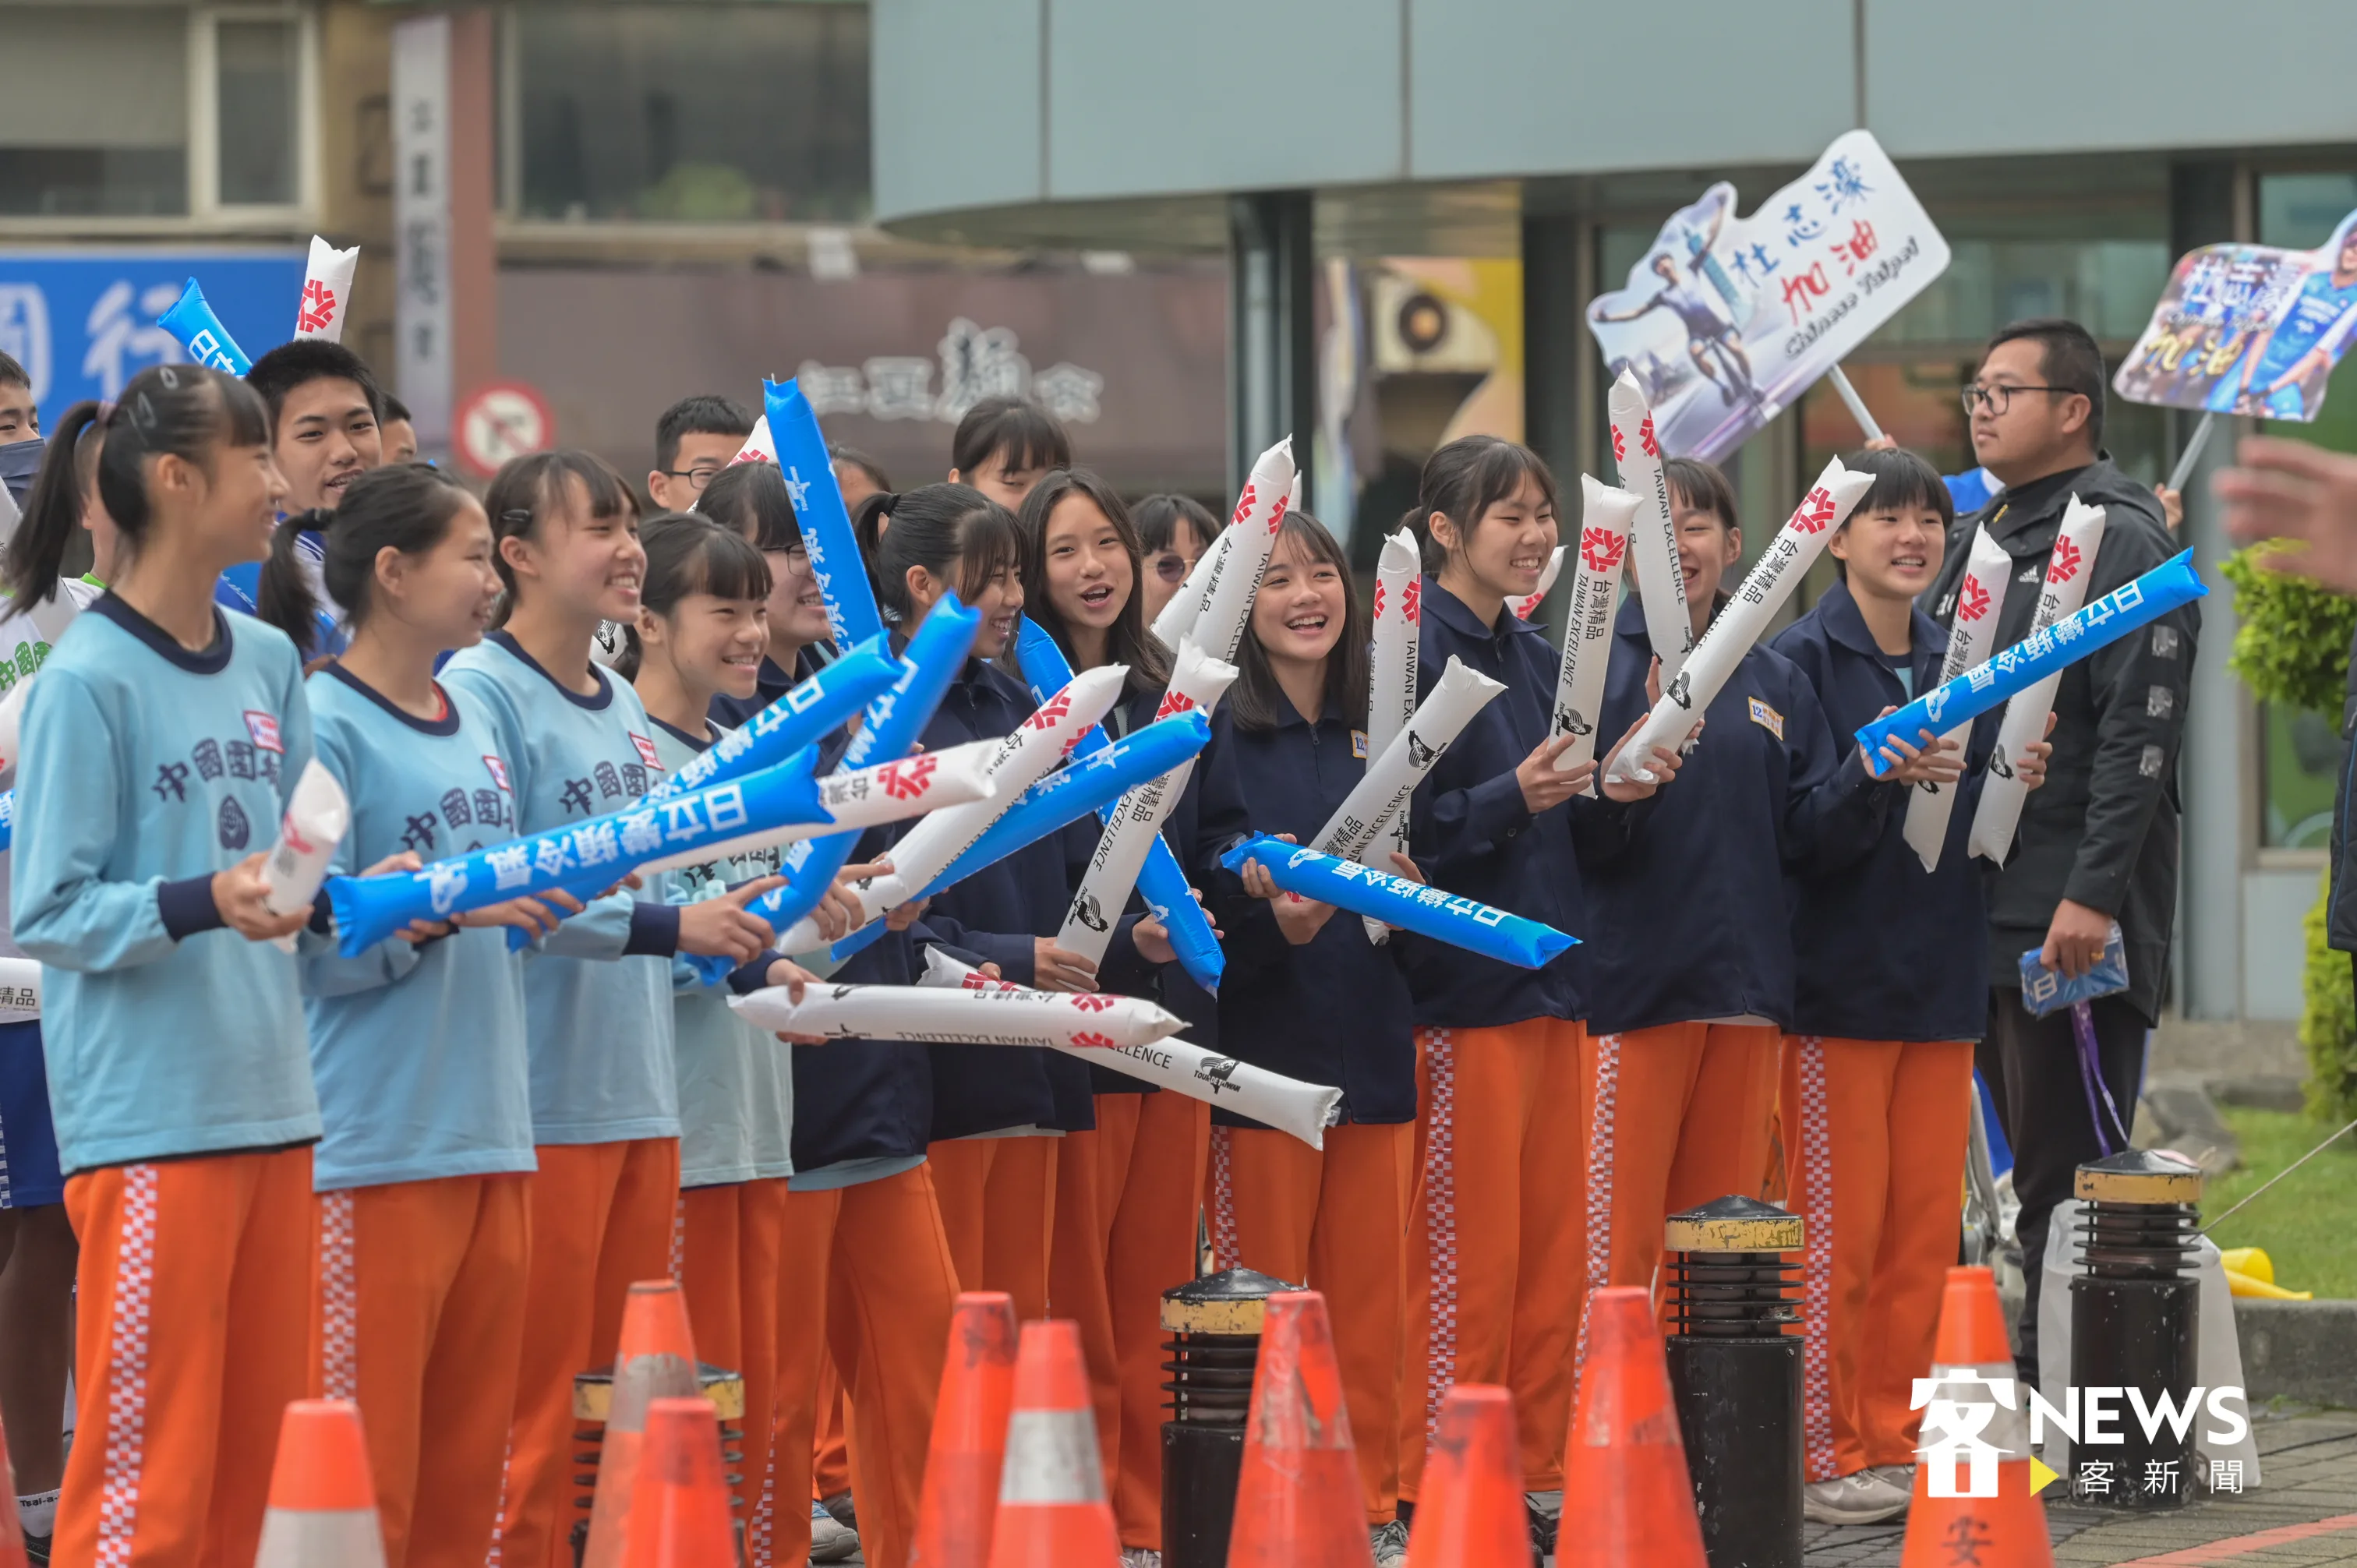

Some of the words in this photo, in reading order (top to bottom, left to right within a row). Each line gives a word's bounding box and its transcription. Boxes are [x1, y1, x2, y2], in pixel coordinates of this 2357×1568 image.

[1780, 219, 1878, 327] 加油
[1653, 467, 1670, 520] TAIWAN
[1663, 522, 1687, 606] EXCELLENCE
[1246, 552, 1270, 605] TAIWAN
[1574, 572, 1589, 618] TAIWAN
[1742, 538, 1799, 605] 台灣精品
[1584, 579, 1613, 641] 台灣精品
[1963, 579, 2145, 694] 日立變頻冷氣
[1405, 637, 1418, 694] TAIWAN
[1562, 618, 1582, 688] EXCELLENCE
[484, 782, 749, 891] 日立變頻冷氣
[1093, 793, 1133, 872] EXCELLENCE
[1363, 783, 1415, 841] EXCELLENCE
[1193, 1070, 1210, 1082] TOUR
[1217, 1080, 1241, 1093] TAIWAN
[1941, 1515, 1993, 1568] 安
